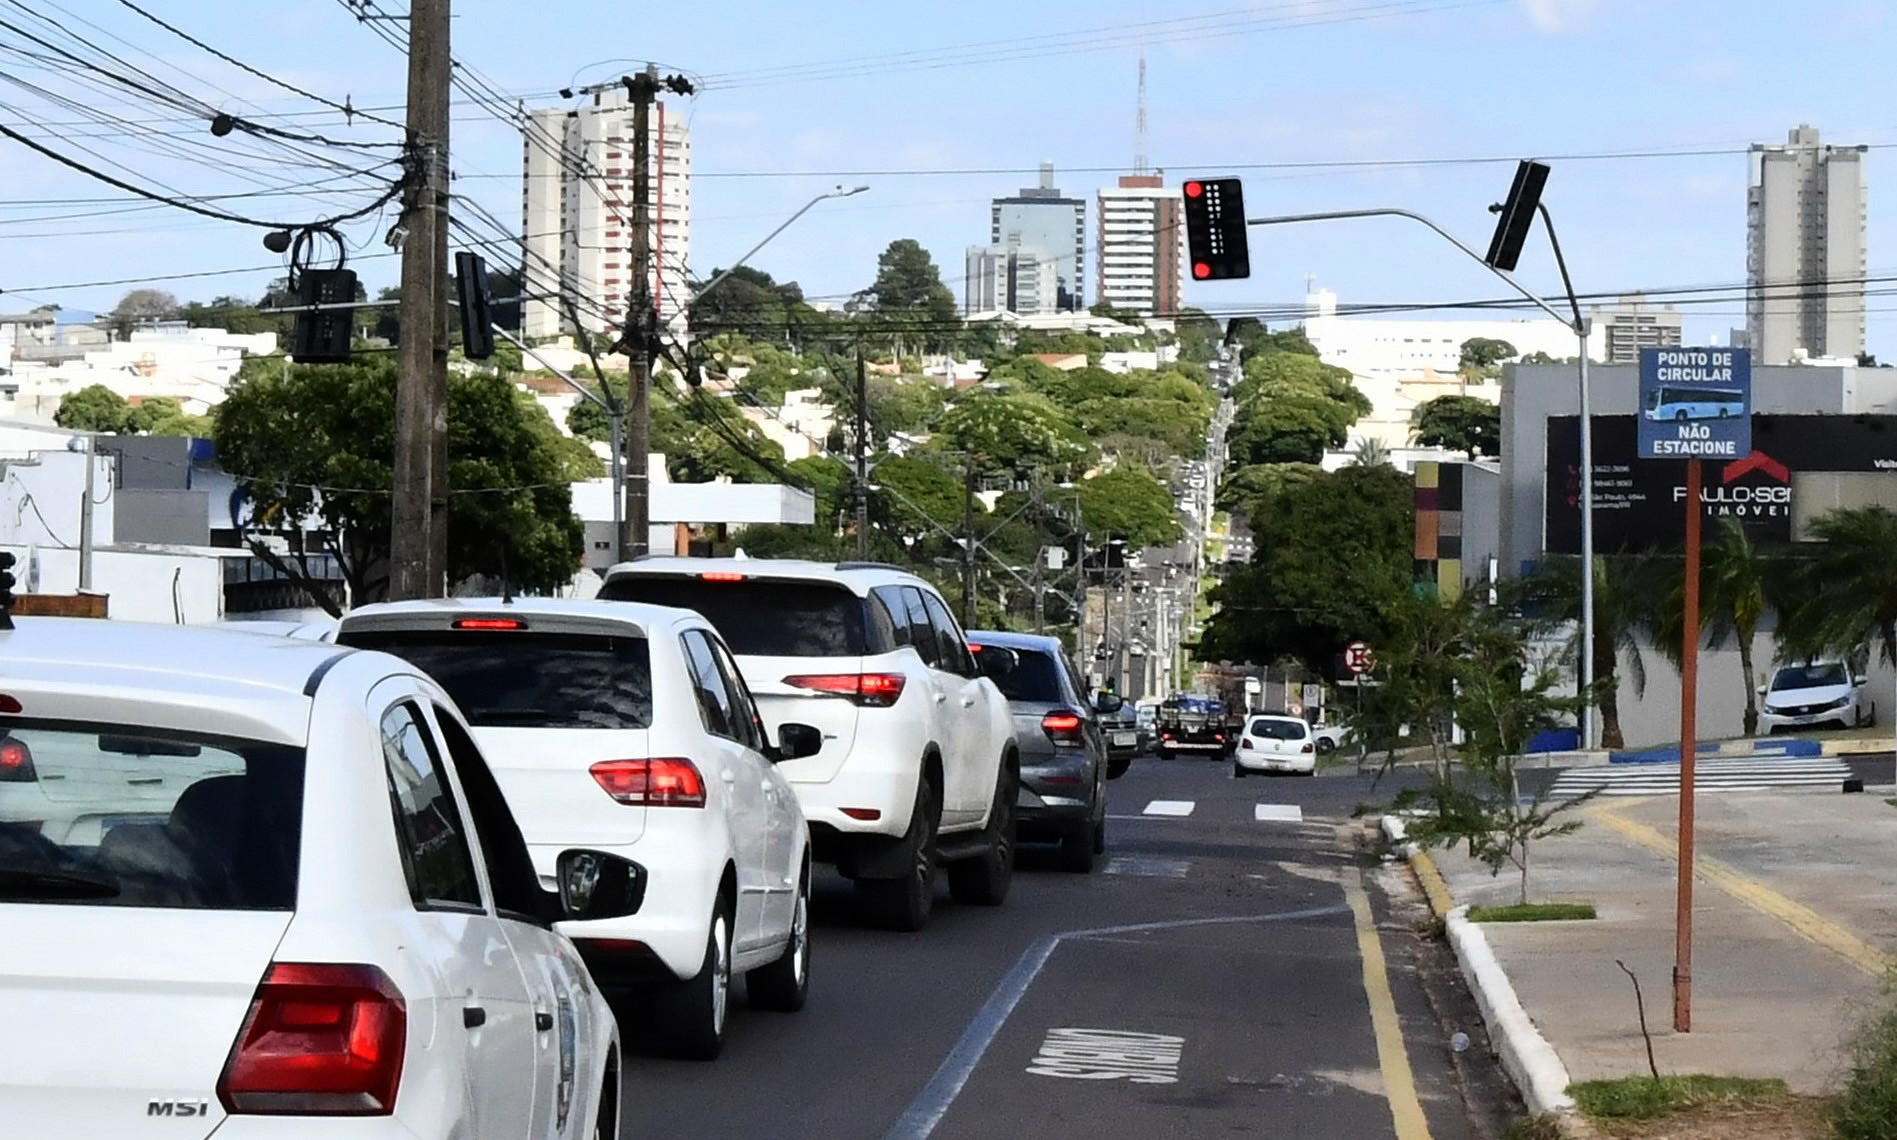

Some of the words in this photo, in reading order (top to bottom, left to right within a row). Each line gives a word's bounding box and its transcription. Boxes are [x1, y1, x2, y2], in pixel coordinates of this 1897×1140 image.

[1658, 352, 1707, 365] PONTO
[1712, 352, 1732, 366] DE
[1657, 368, 1732, 381] CIRCULAR
[1678, 422, 1710, 439] NÃO
[1653, 440, 1736, 454] ESTACIONE
[147, 1099, 208, 1117] MSI
